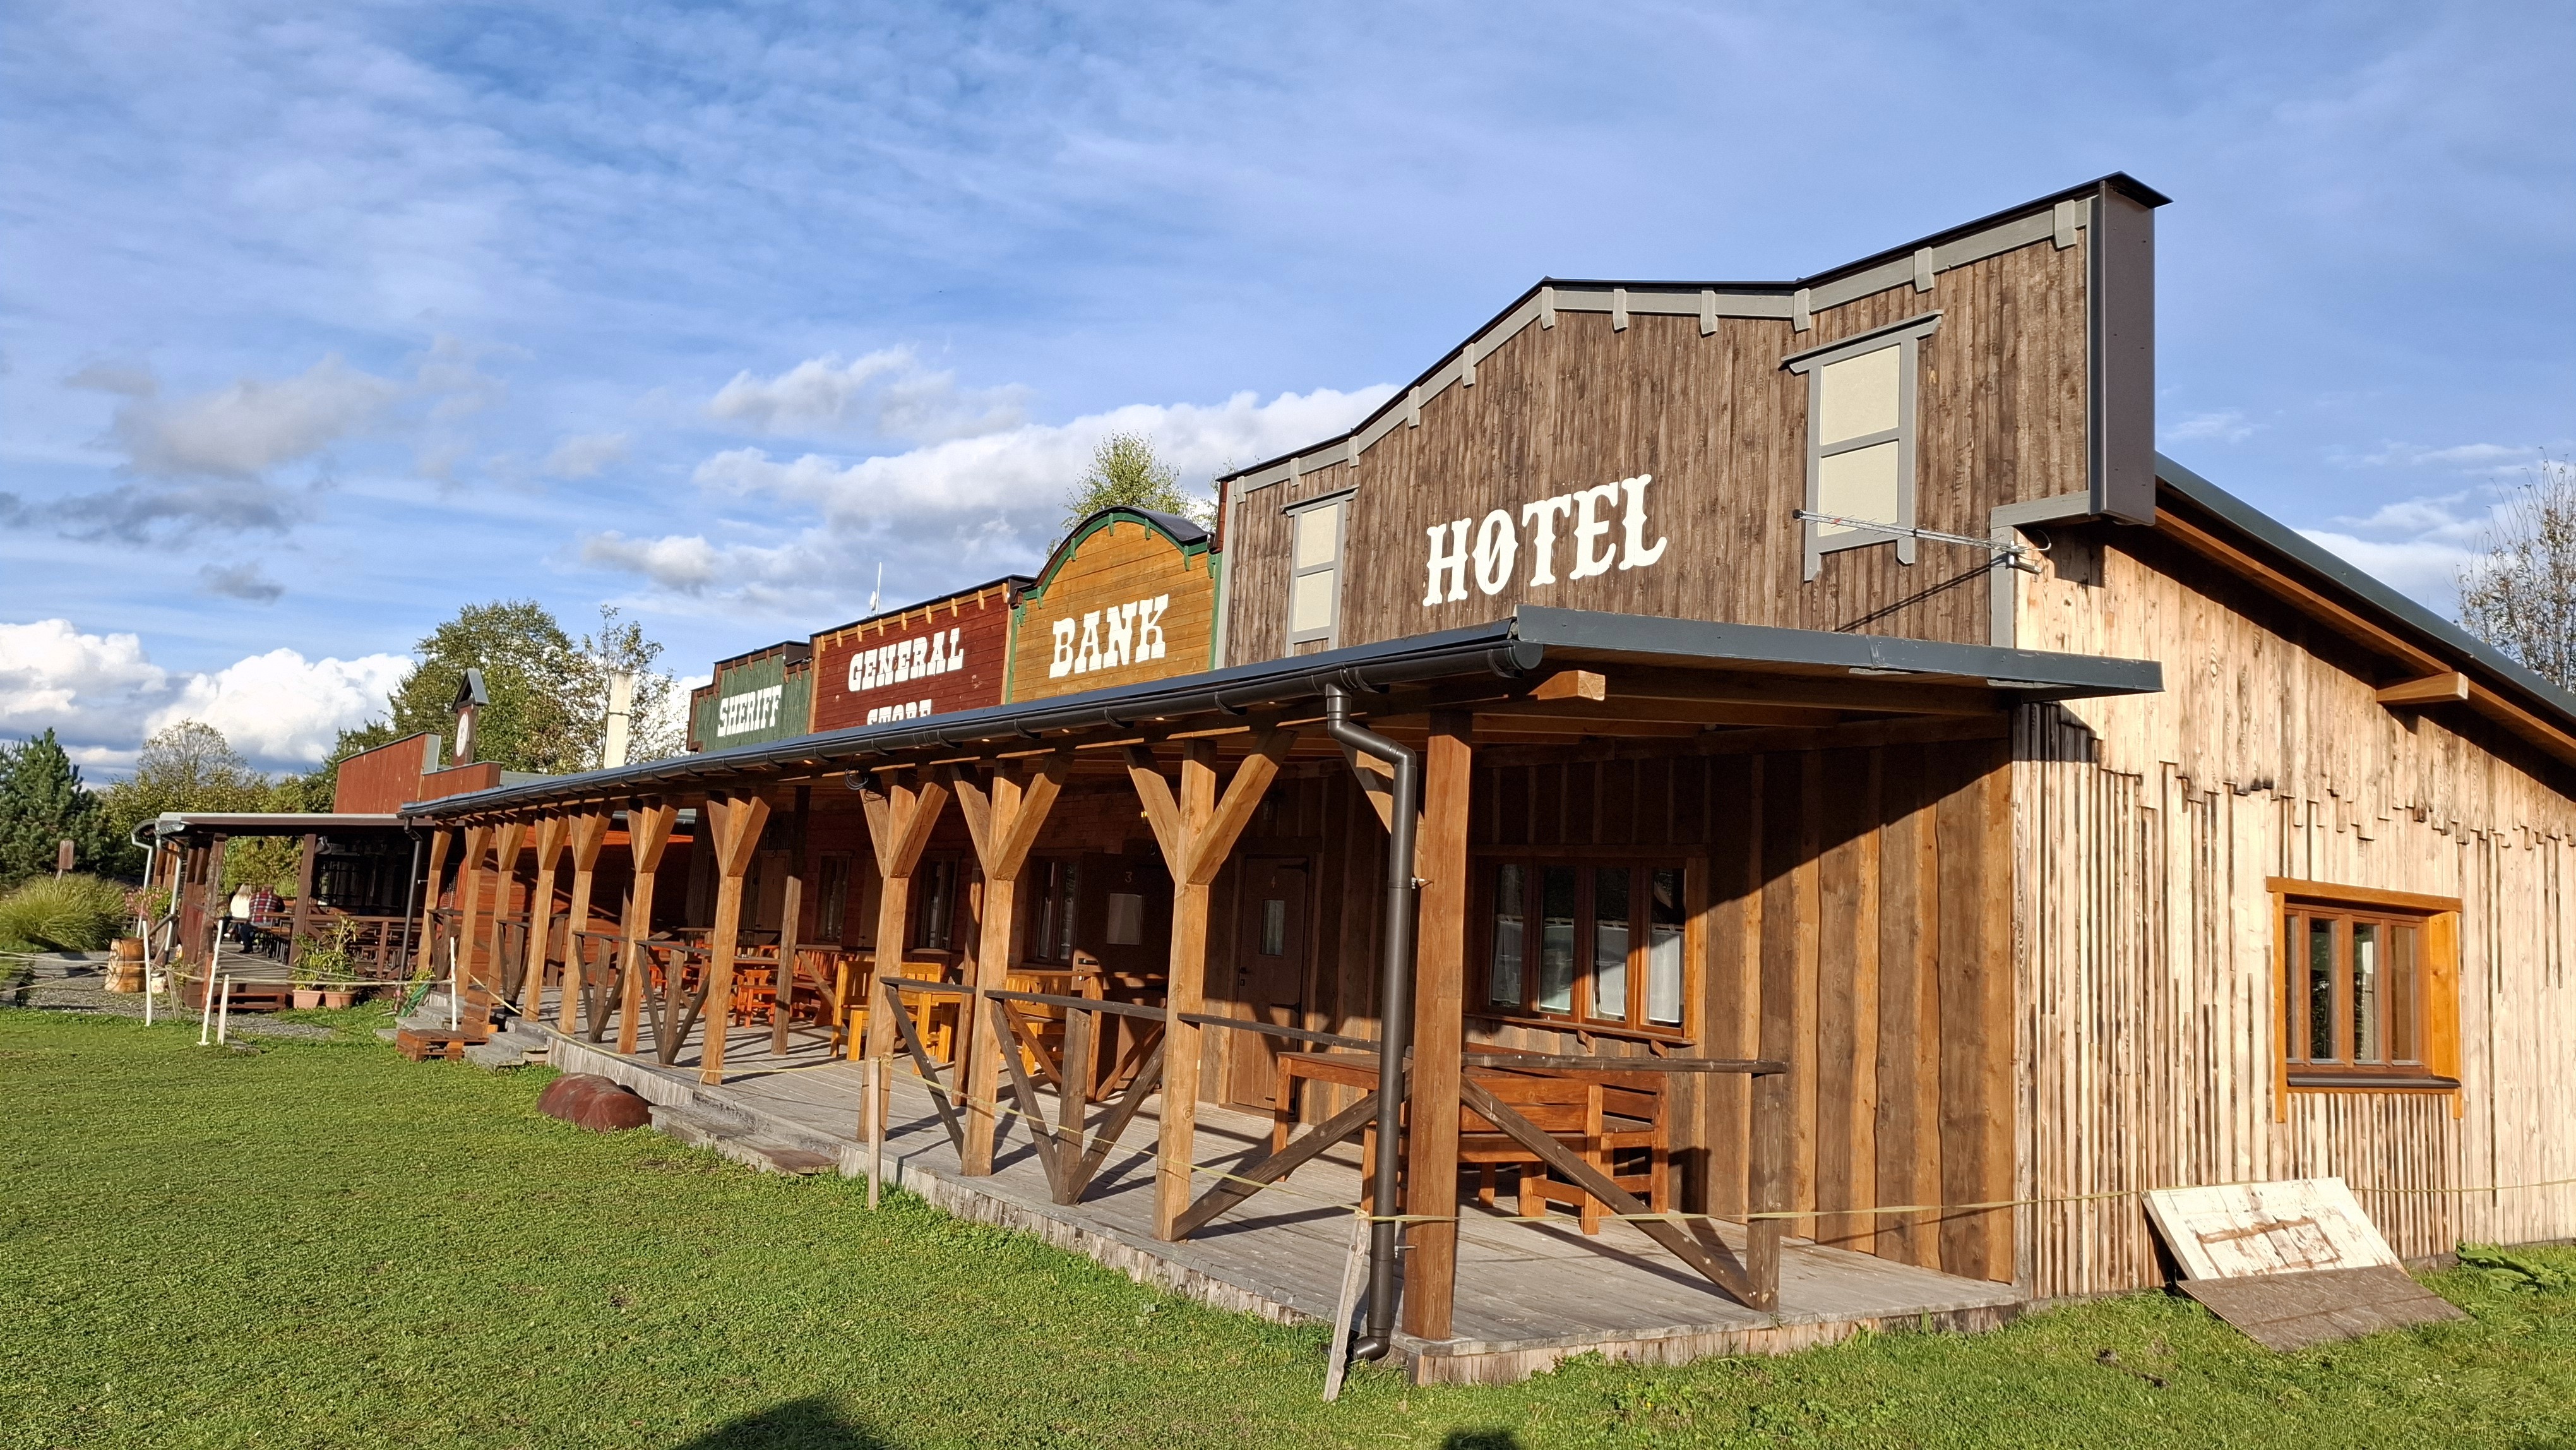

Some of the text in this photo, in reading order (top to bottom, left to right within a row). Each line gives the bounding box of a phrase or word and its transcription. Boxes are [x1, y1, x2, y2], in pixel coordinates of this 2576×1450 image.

[849, 627, 964, 692] GENERAL
[1049, 594, 1169, 679] BANK
[717, 684, 782, 738] SHERIFF
[1125, 872, 1133, 883] 3
